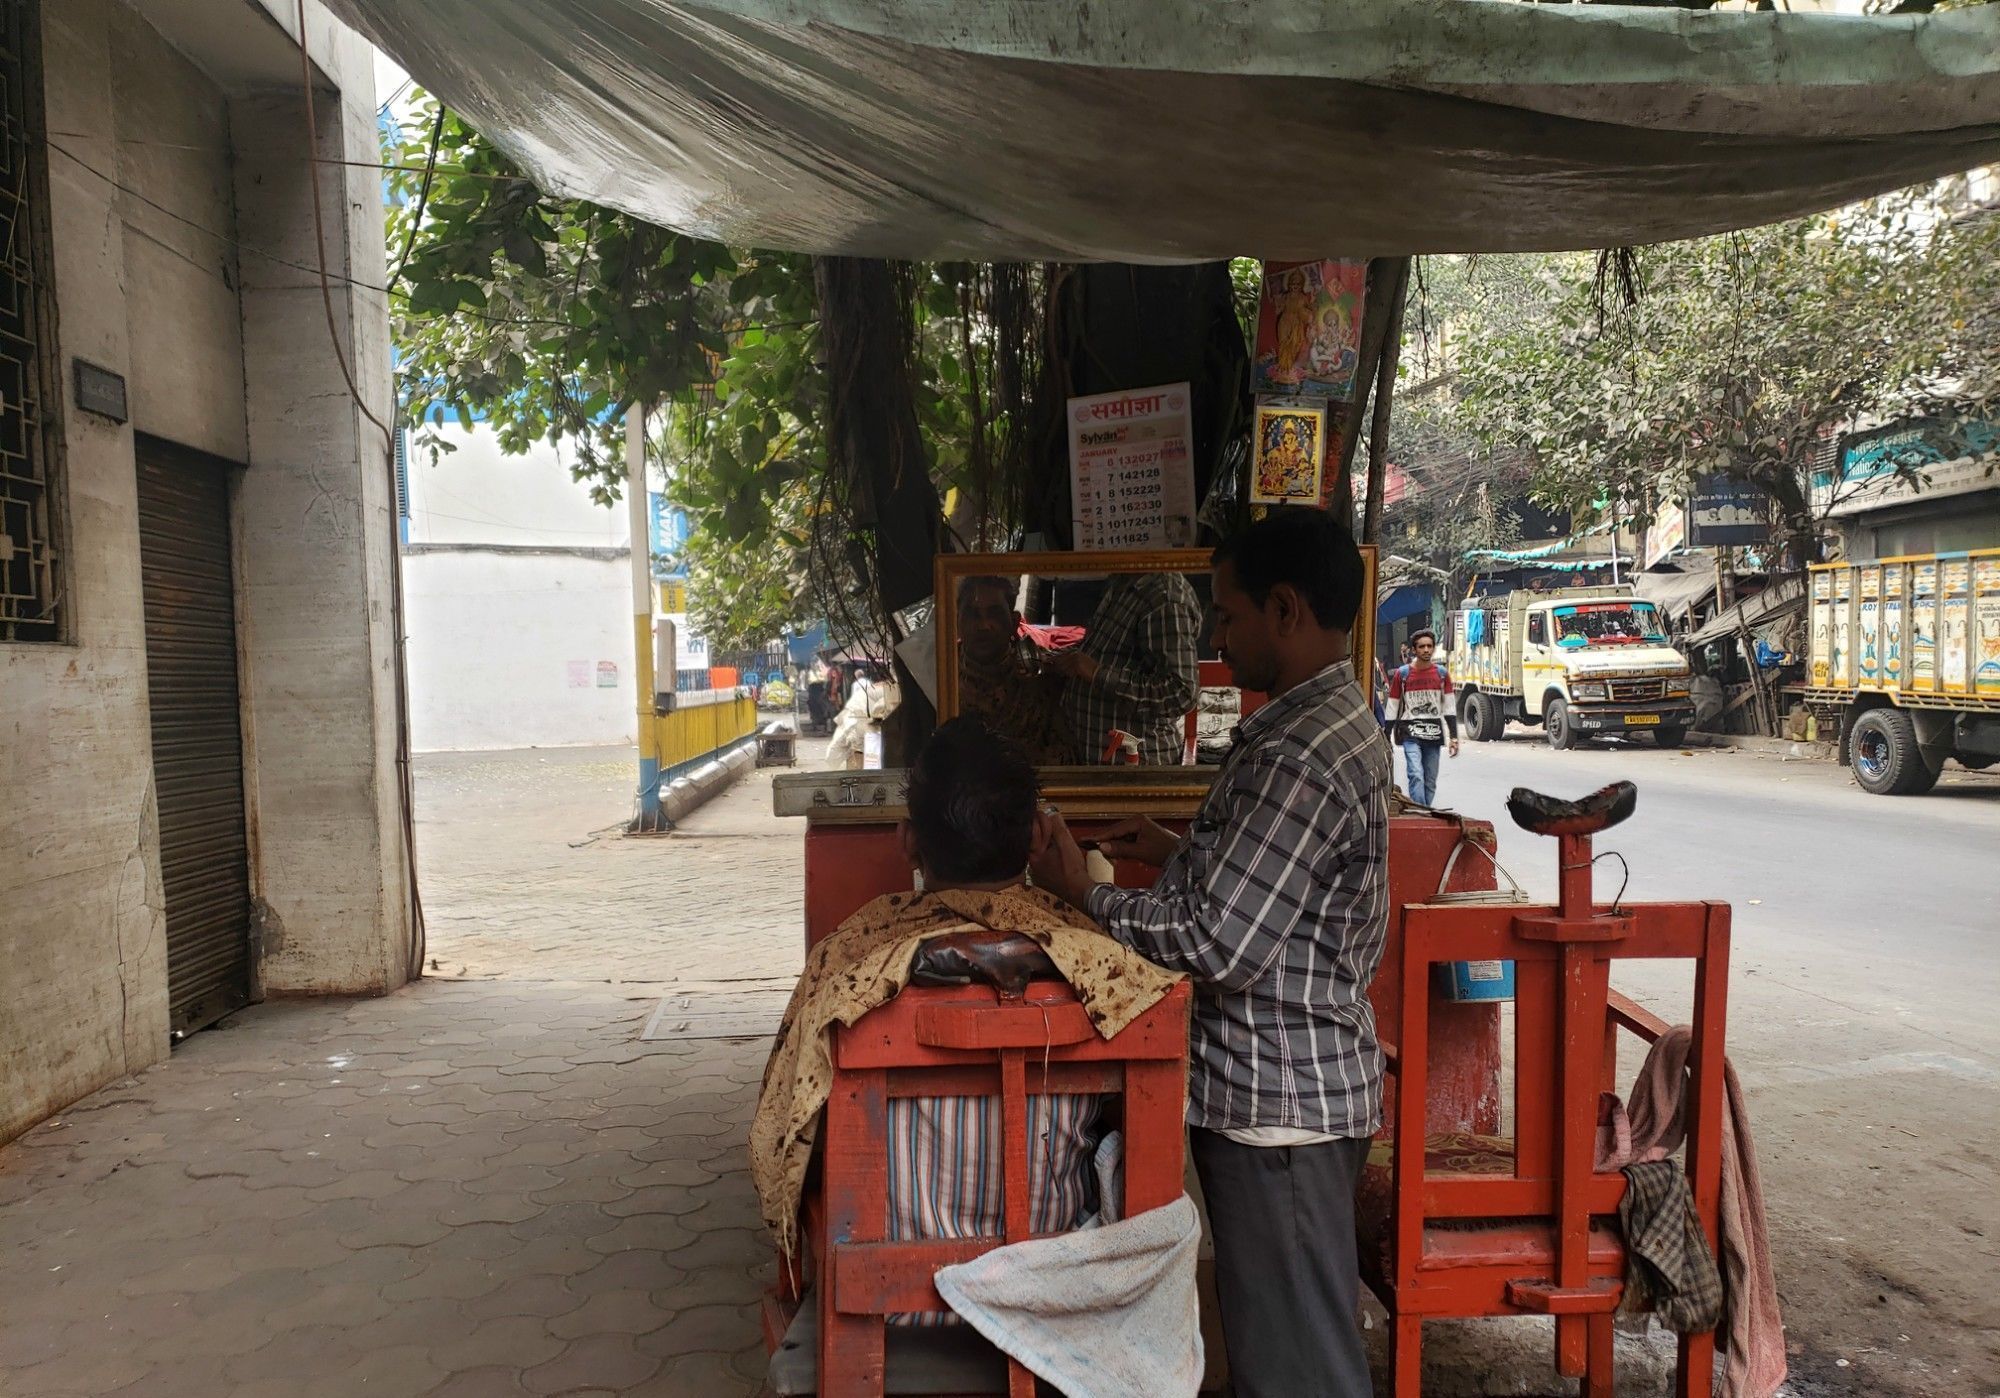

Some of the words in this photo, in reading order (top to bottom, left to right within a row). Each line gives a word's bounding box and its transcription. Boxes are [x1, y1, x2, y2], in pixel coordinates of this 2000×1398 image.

[1080, 447, 1118, 457] JANUARY
[1862, 603, 1878, 611] ROY
[1582, 720, 1601, 729] SPEED
